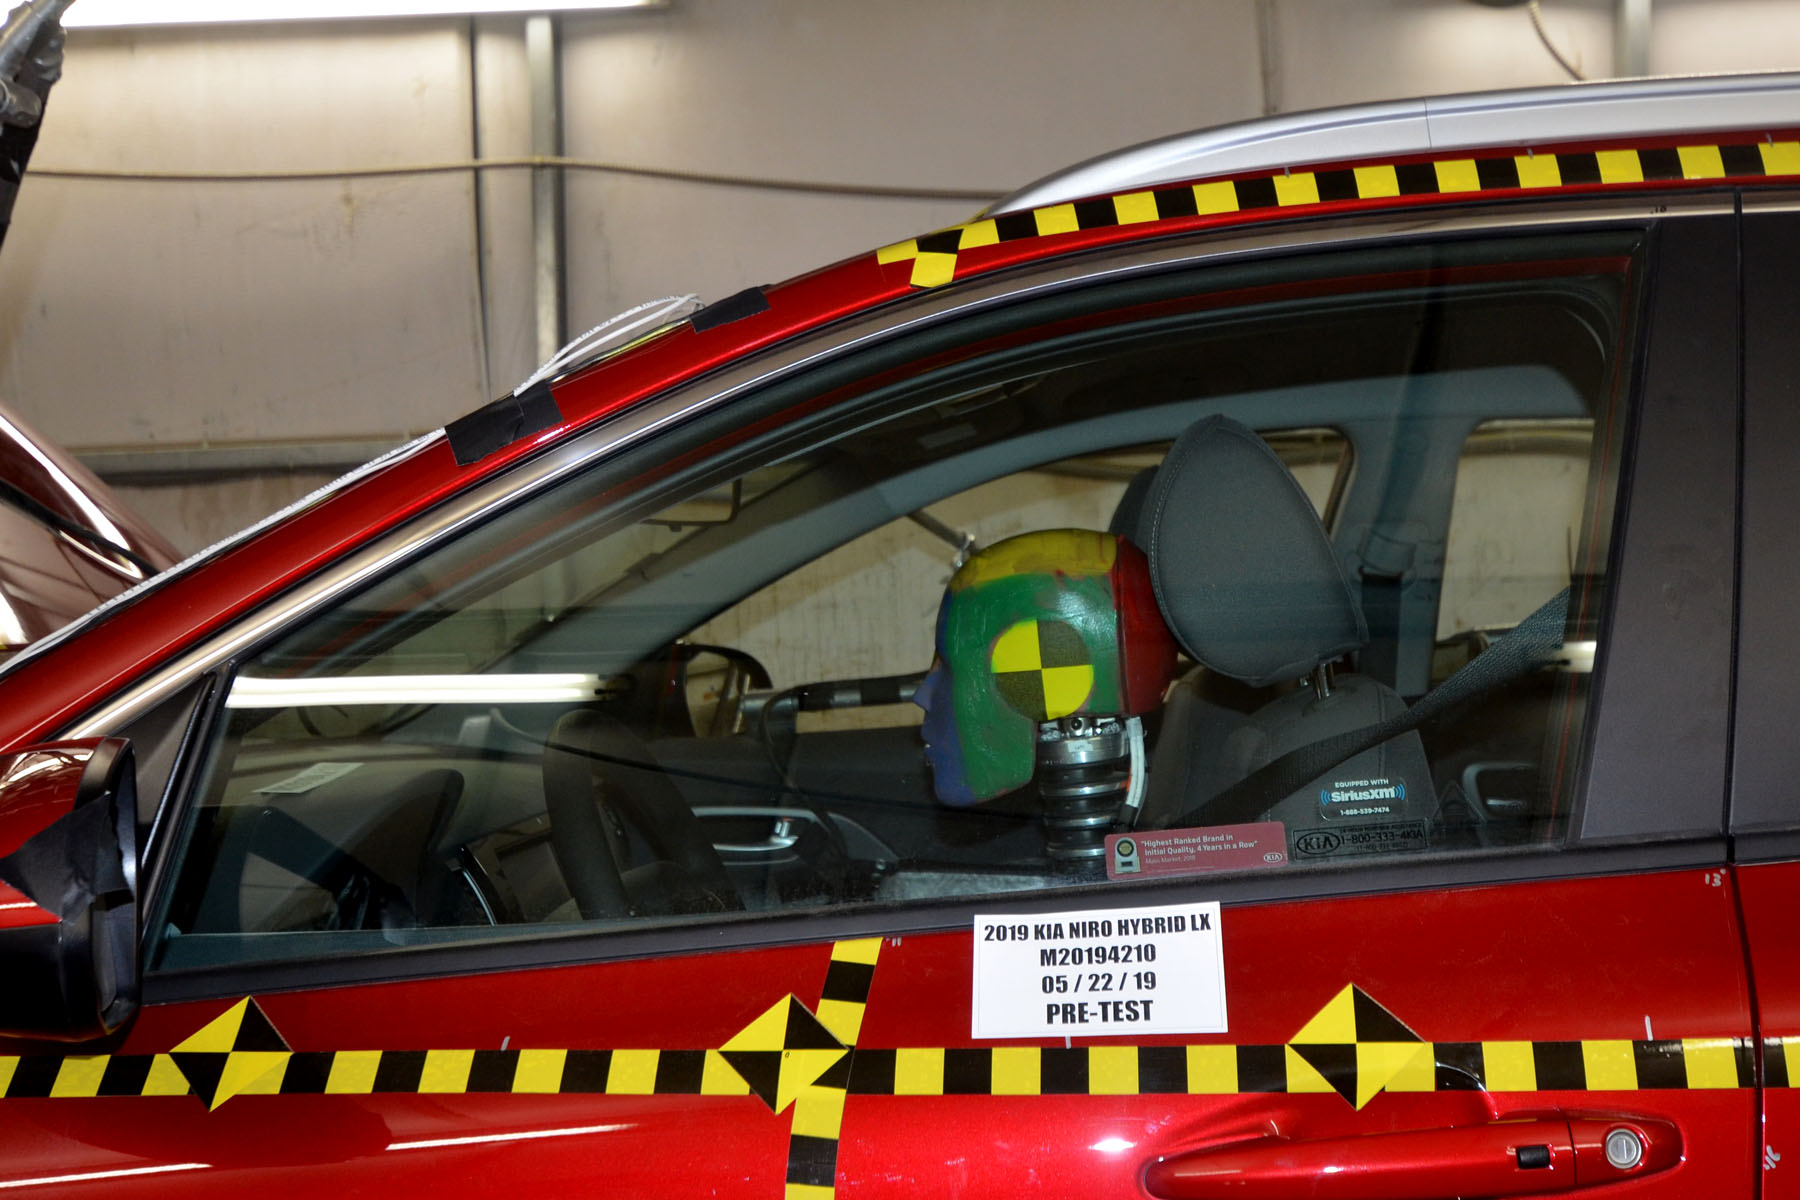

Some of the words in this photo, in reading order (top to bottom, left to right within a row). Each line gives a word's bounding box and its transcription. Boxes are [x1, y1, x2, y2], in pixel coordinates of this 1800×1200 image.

[1334, 779, 1369, 788] EQUIPPED
[1370, 778, 1389, 786] WITH
[1173, 836, 1201, 845] Ranked
[1202, 834, 1225, 843] Brand
[1226, 833, 1234, 842] in
[1303, 836, 1334, 851] KIA
[1144, 848, 1166, 857] Initial
[1197, 844, 1203, 852] 4
[1203, 843, 1223, 851] Years
[1224, 841, 1231, 850] in
[984, 924, 1029, 942] 2019
[1034, 923, 1064, 940] KIA
[1069, 920, 1112, 939] NIRO
[1118, 915, 1186, 937] HYBRID
[1191, 913, 1211, 932] LX
[1040, 943, 1157, 967] M20194210
[1042, 975, 1068, 994] 05
[1074, 974, 1083, 993] /
[1088, 973, 1113, 992] 22
[1119, 972, 1128, 991] /
[1133, 971, 1157, 990] 19
[1046, 999, 1154, 1025] PRE-TEST
